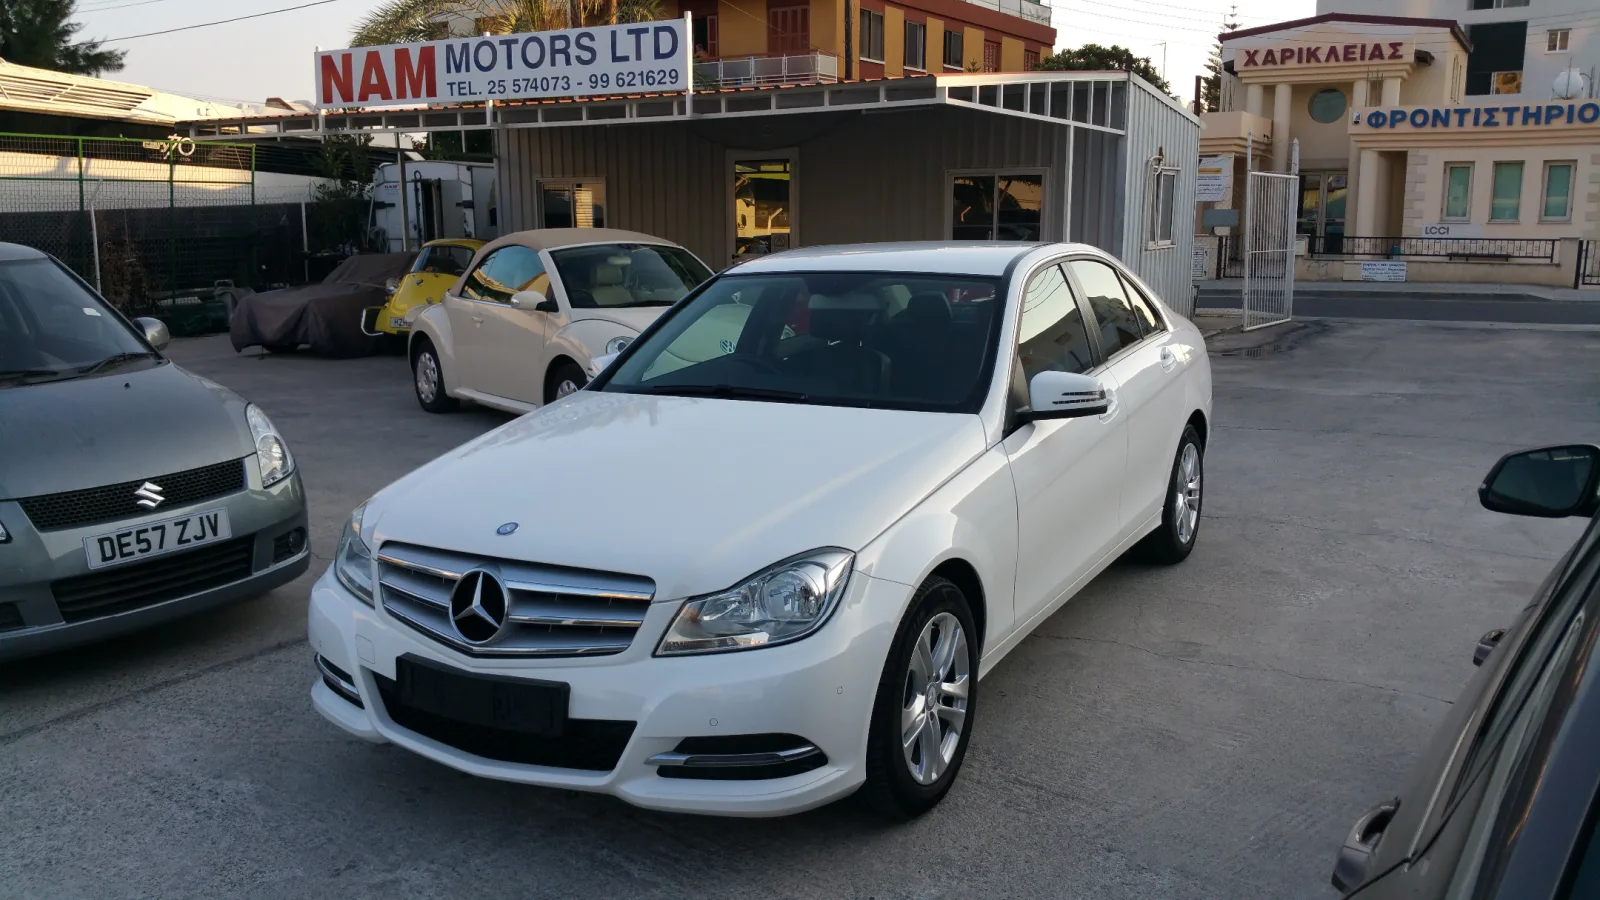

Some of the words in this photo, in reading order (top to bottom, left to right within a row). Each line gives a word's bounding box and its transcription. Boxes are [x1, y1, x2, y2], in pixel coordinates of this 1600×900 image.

[445, 32, 597, 74] MOTORS
[610, 25, 679, 63] LTD
[1243, 42, 1404, 67] ΧΑΡΙΚΛΕΙΑΣ
[321, 45, 437, 104] NAM
[447, 82, 482, 97] TEL.
[487, 79, 507, 95] 25
[512, 75, 571, 93] 574073
[588, 73, 610, 89] 99
[615, 68, 679, 87] 621629
[1366, 102, 1600, 129] ΦΡΟΝΤΙΣΤΗΡΙΟ
[1424, 226, 1450, 236] LCCI
[97, 524, 166, 563] DE57
[174, 513, 219, 546] ZJV
